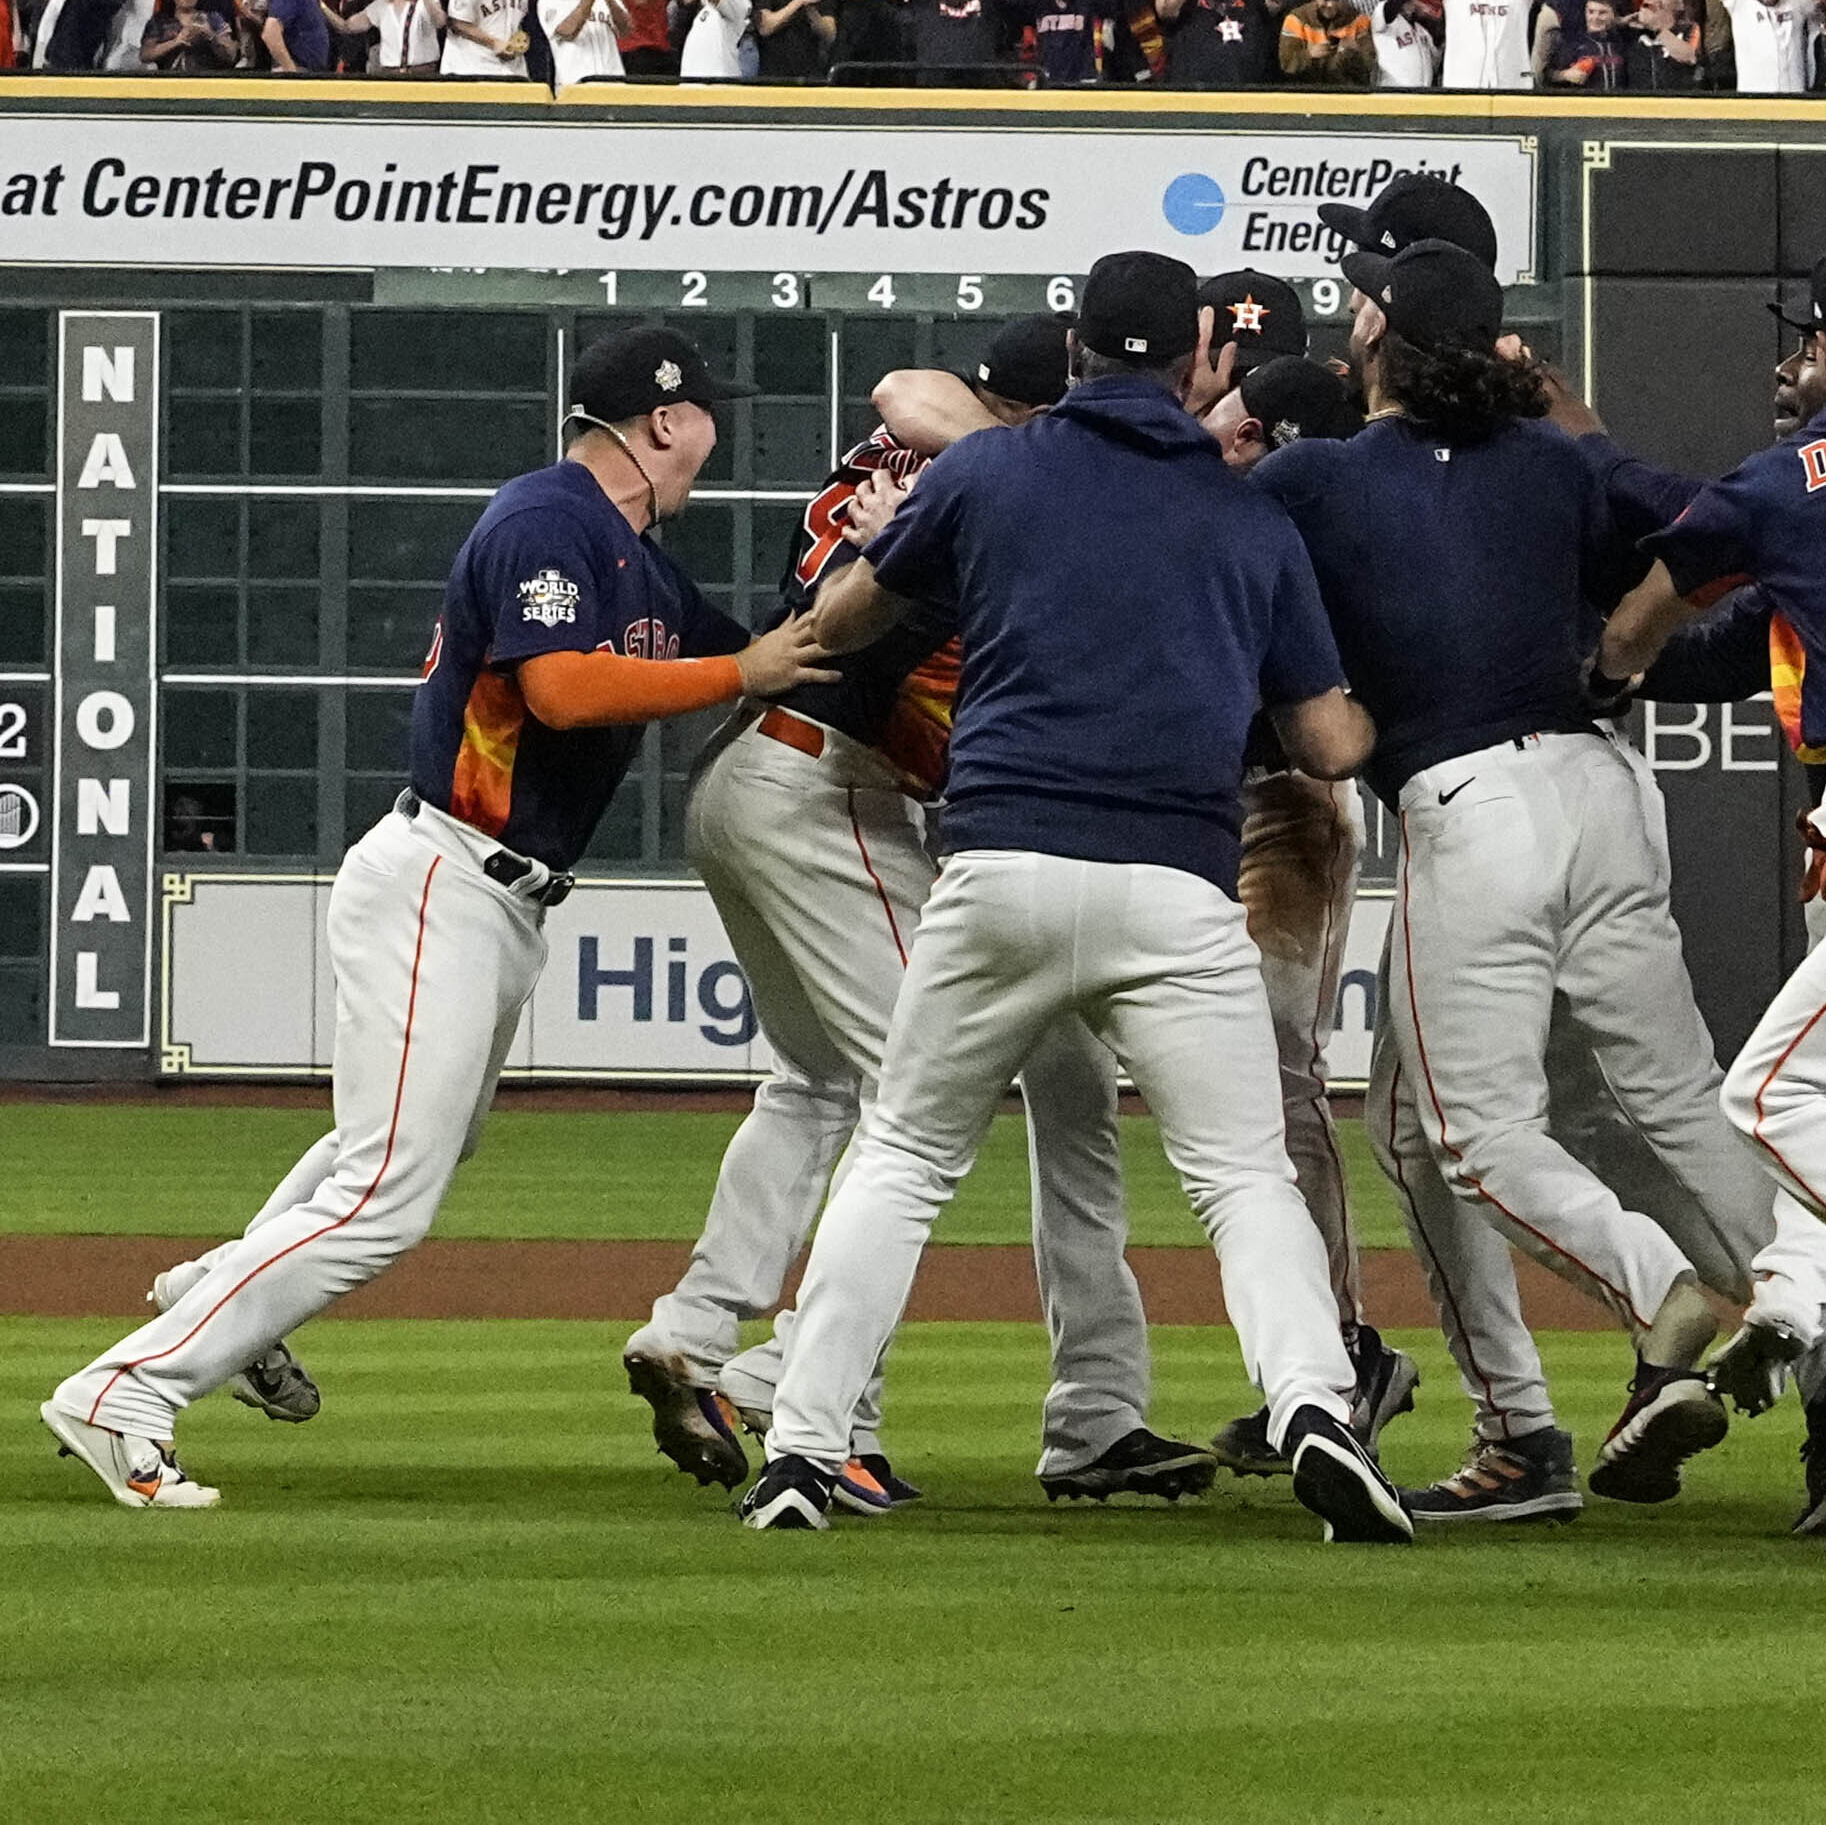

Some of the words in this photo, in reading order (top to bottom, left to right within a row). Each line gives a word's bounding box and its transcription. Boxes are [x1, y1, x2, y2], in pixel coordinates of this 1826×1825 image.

[2, 165, 65, 218] at
[83, 155, 1050, 241] CenterPointEnergy.com/Astros
[1241, 212, 1351, 265] Energ
[598, 271, 617, 306] 1
[680, 270, 708, 307] 2
[771, 272, 800, 309] 3
[867, 274, 897, 309] 4
[956, 275, 984, 311] 5
[1046, 276, 1075, 313] 6
[1312, 279, 1341, 315] 9
[1231, 303, 1265, 333] H
[519, 578, 580, 596] WORLD
[522, 605, 577, 624] SERIES
[71, 345, 138, 1009] NATIONAL
